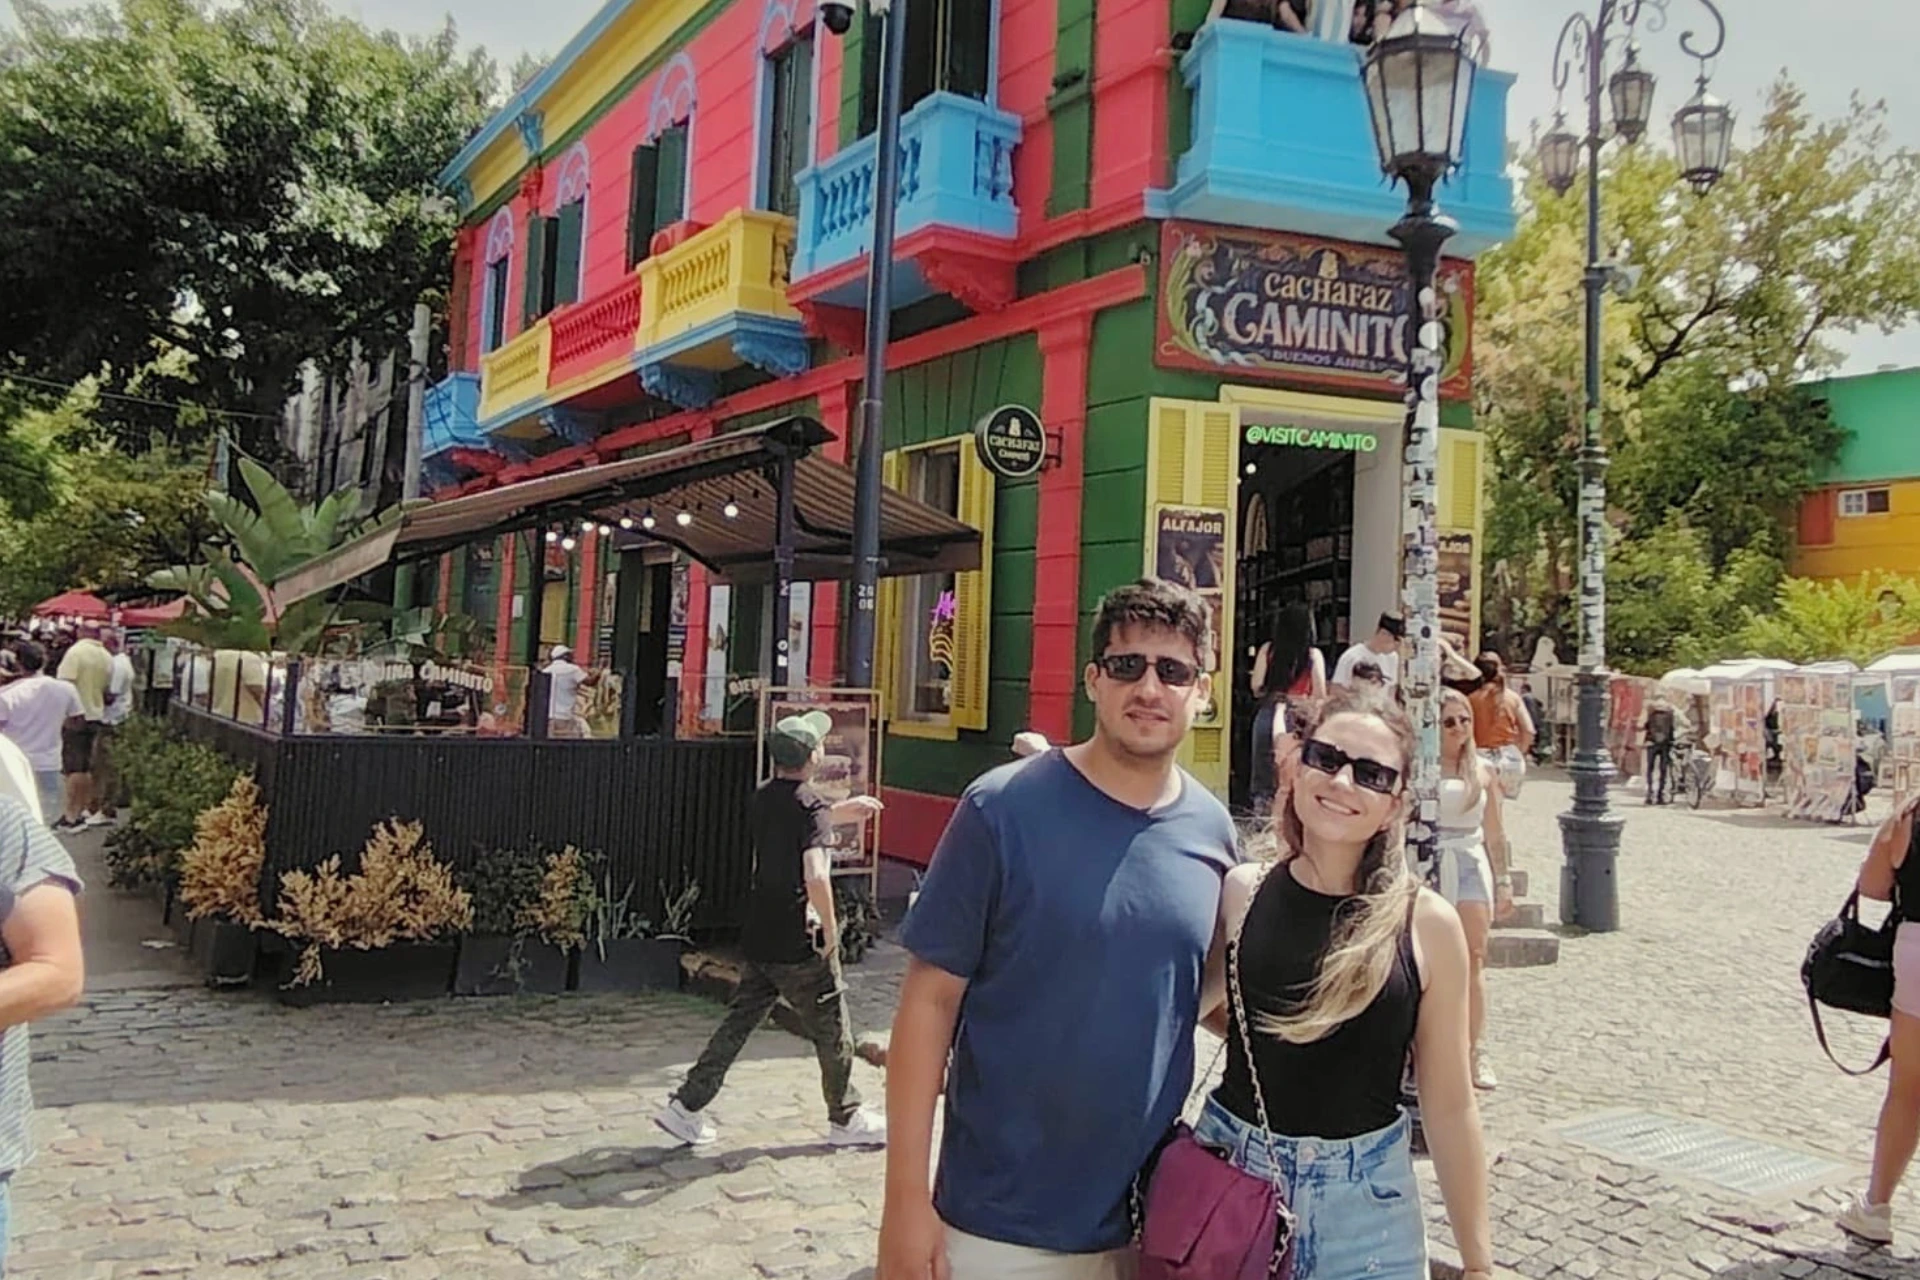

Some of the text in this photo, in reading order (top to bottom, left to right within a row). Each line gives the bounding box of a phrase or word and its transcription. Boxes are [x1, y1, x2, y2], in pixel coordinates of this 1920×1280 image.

[1272, 350, 1331, 366] BUENOS
[1245, 425, 1377, 452] @VISITCAMINITO
[1161, 516, 1222, 535] ALFAJOR
[419, 660, 493, 693] CAMINITO
